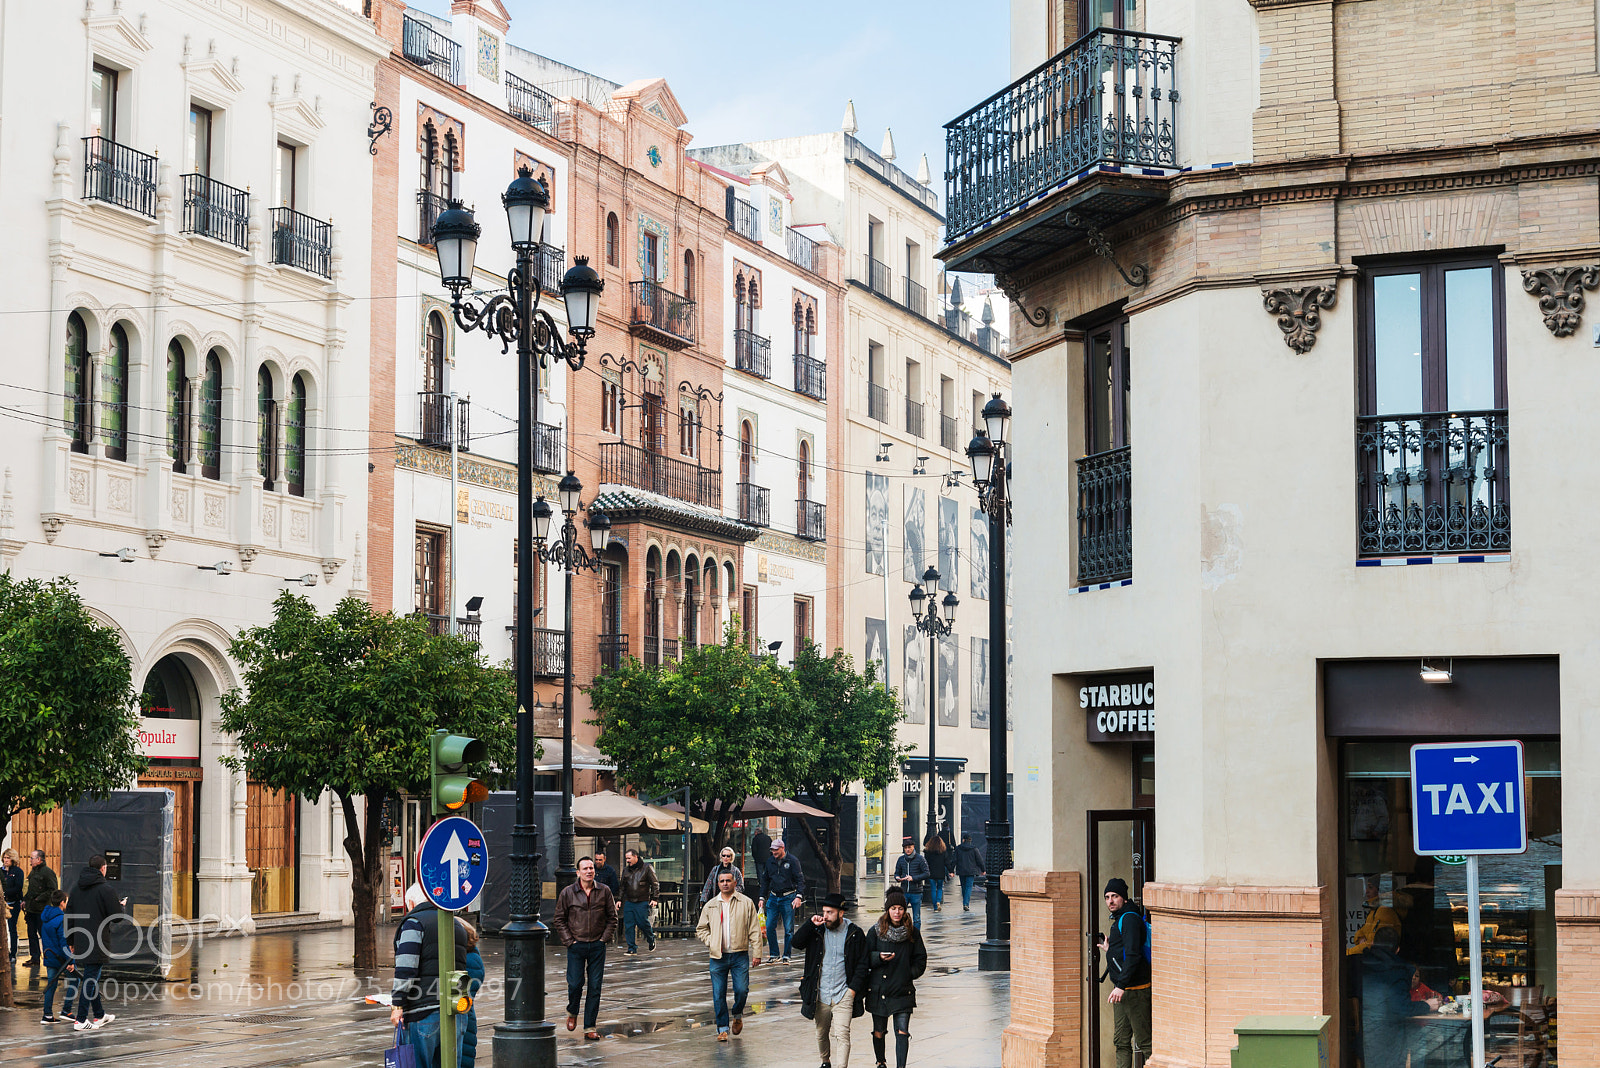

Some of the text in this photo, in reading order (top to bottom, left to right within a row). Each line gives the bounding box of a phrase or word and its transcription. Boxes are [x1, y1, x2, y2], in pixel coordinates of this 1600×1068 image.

[903, 774, 922, 793] fnac
[938, 775, 956, 793] fnac
[1422, 781, 1515, 816] TAXI
